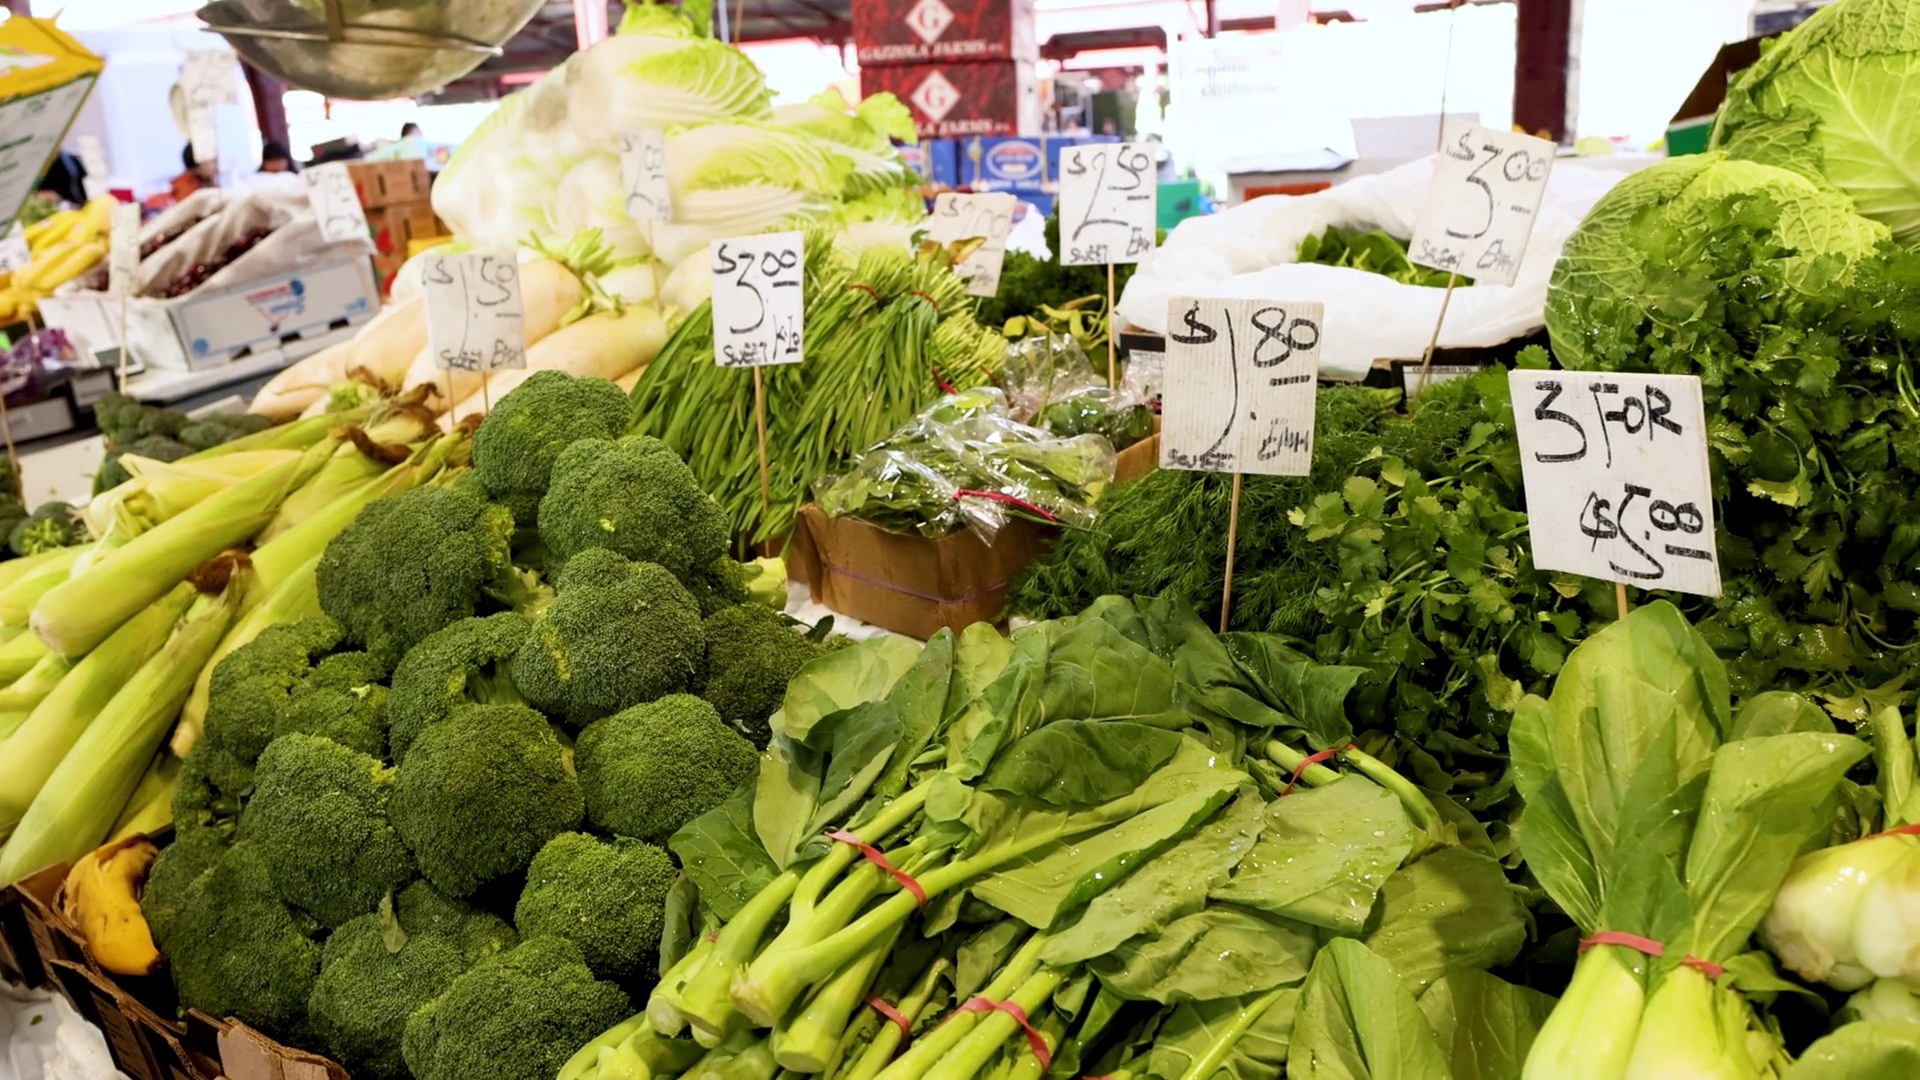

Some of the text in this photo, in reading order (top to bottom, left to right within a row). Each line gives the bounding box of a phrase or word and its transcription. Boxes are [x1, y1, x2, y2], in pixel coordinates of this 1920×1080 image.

[917, 5, 940, 29] G
[931, 39, 987, 58] FARMS
[923, 84, 946, 109] G
[1535, 380, 1683, 469] 3 FOR
